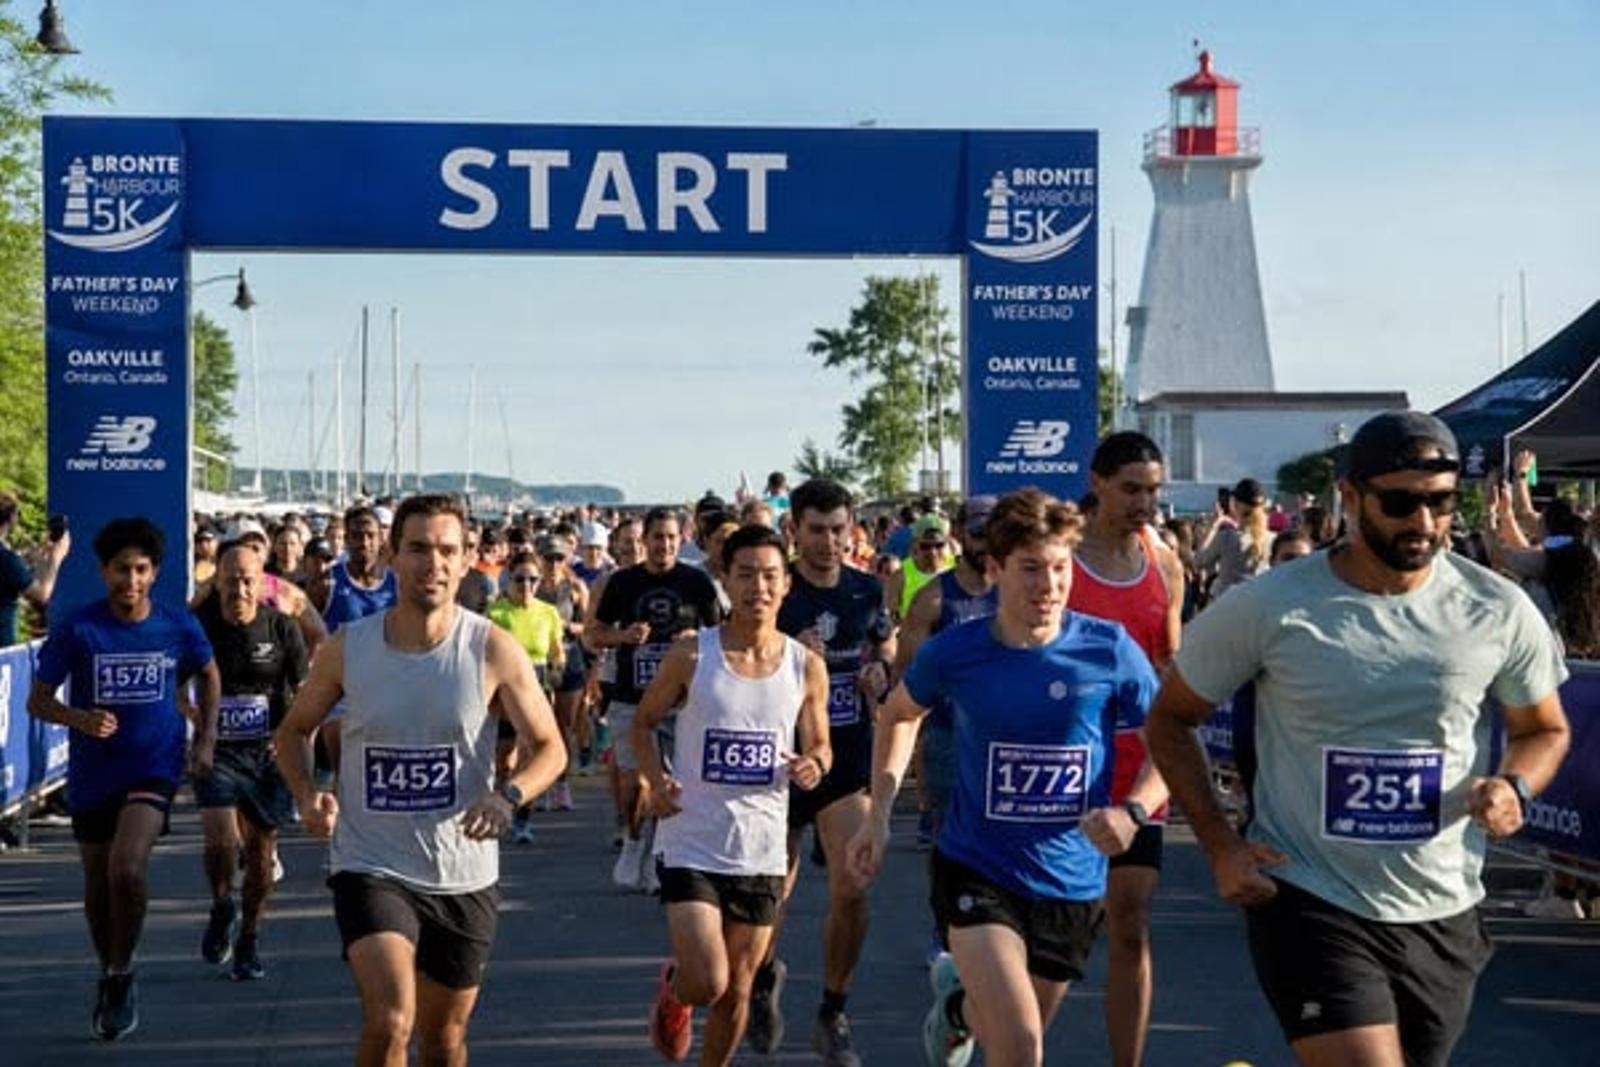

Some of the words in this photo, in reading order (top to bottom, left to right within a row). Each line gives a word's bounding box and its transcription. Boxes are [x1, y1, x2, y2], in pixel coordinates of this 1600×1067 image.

[91, 155, 180, 174] BRONTE
[1012, 168, 1095, 186] BRONTE
[93, 178, 180, 195] HARBOUR
[438, 146, 789, 234] START
[1014, 190, 1095, 207] HARBOUR
[92, 197, 145, 233] 5K
[1012, 209, 1061, 243] 5K
[52, 276, 138, 292] FATHER'S
[141, 277, 179, 292] DAY
[973, 284, 1053, 300] FATHER'S
[1056, 285, 1092, 300] DAY
[71, 296, 160, 314] WEEKEND
[991, 304, 1074, 320] WEEKEND
[68, 350, 164, 367] OAKVILLE
[988, 356, 1078, 373] OAKVILLE
[63, 371, 118, 385] Ontario,
[120, 371, 168, 384] Canada
[984, 376, 1034, 391] Ontario,
[1035, 376, 1082, 389] Canada
[66, 459, 99, 471] new
[102, 457, 167, 471] balance
[985, 461, 1016, 474] new
[1018, 459, 1079, 474] balance
[101, 664, 159, 688] 1578
[707, 741, 773, 768] 1638
[369, 761, 450, 791] 1452
[997, 763, 1083, 795] 1772
[1344, 772, 1426, 812] 251
